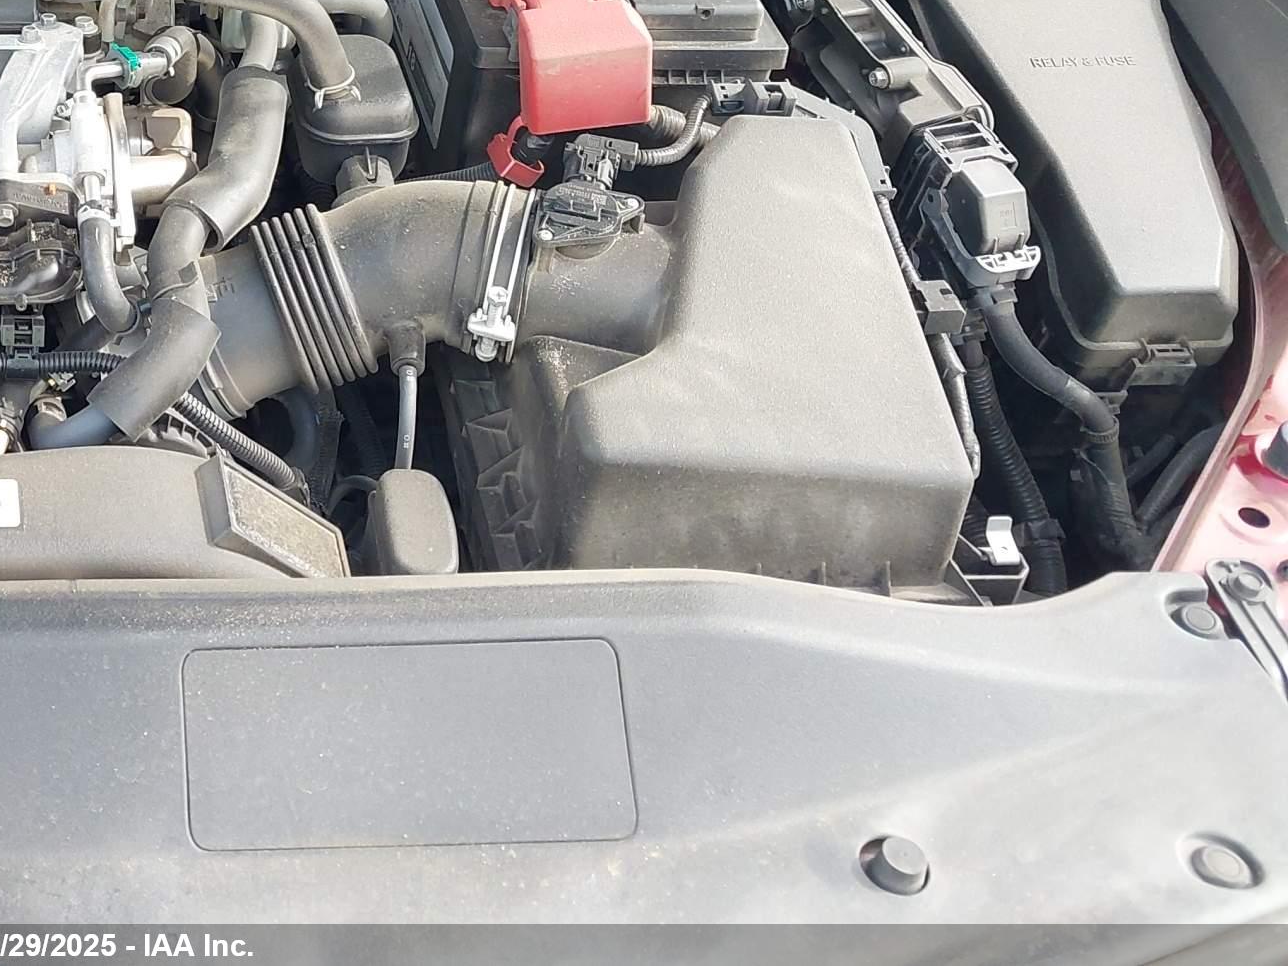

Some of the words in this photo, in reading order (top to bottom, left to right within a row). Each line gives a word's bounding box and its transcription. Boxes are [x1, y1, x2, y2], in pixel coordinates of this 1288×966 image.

[1029, 57, 1078, 68] RELAY
[1081, 57, 1094, 66] &
[1095, 55, 1136, 66] FUSE
